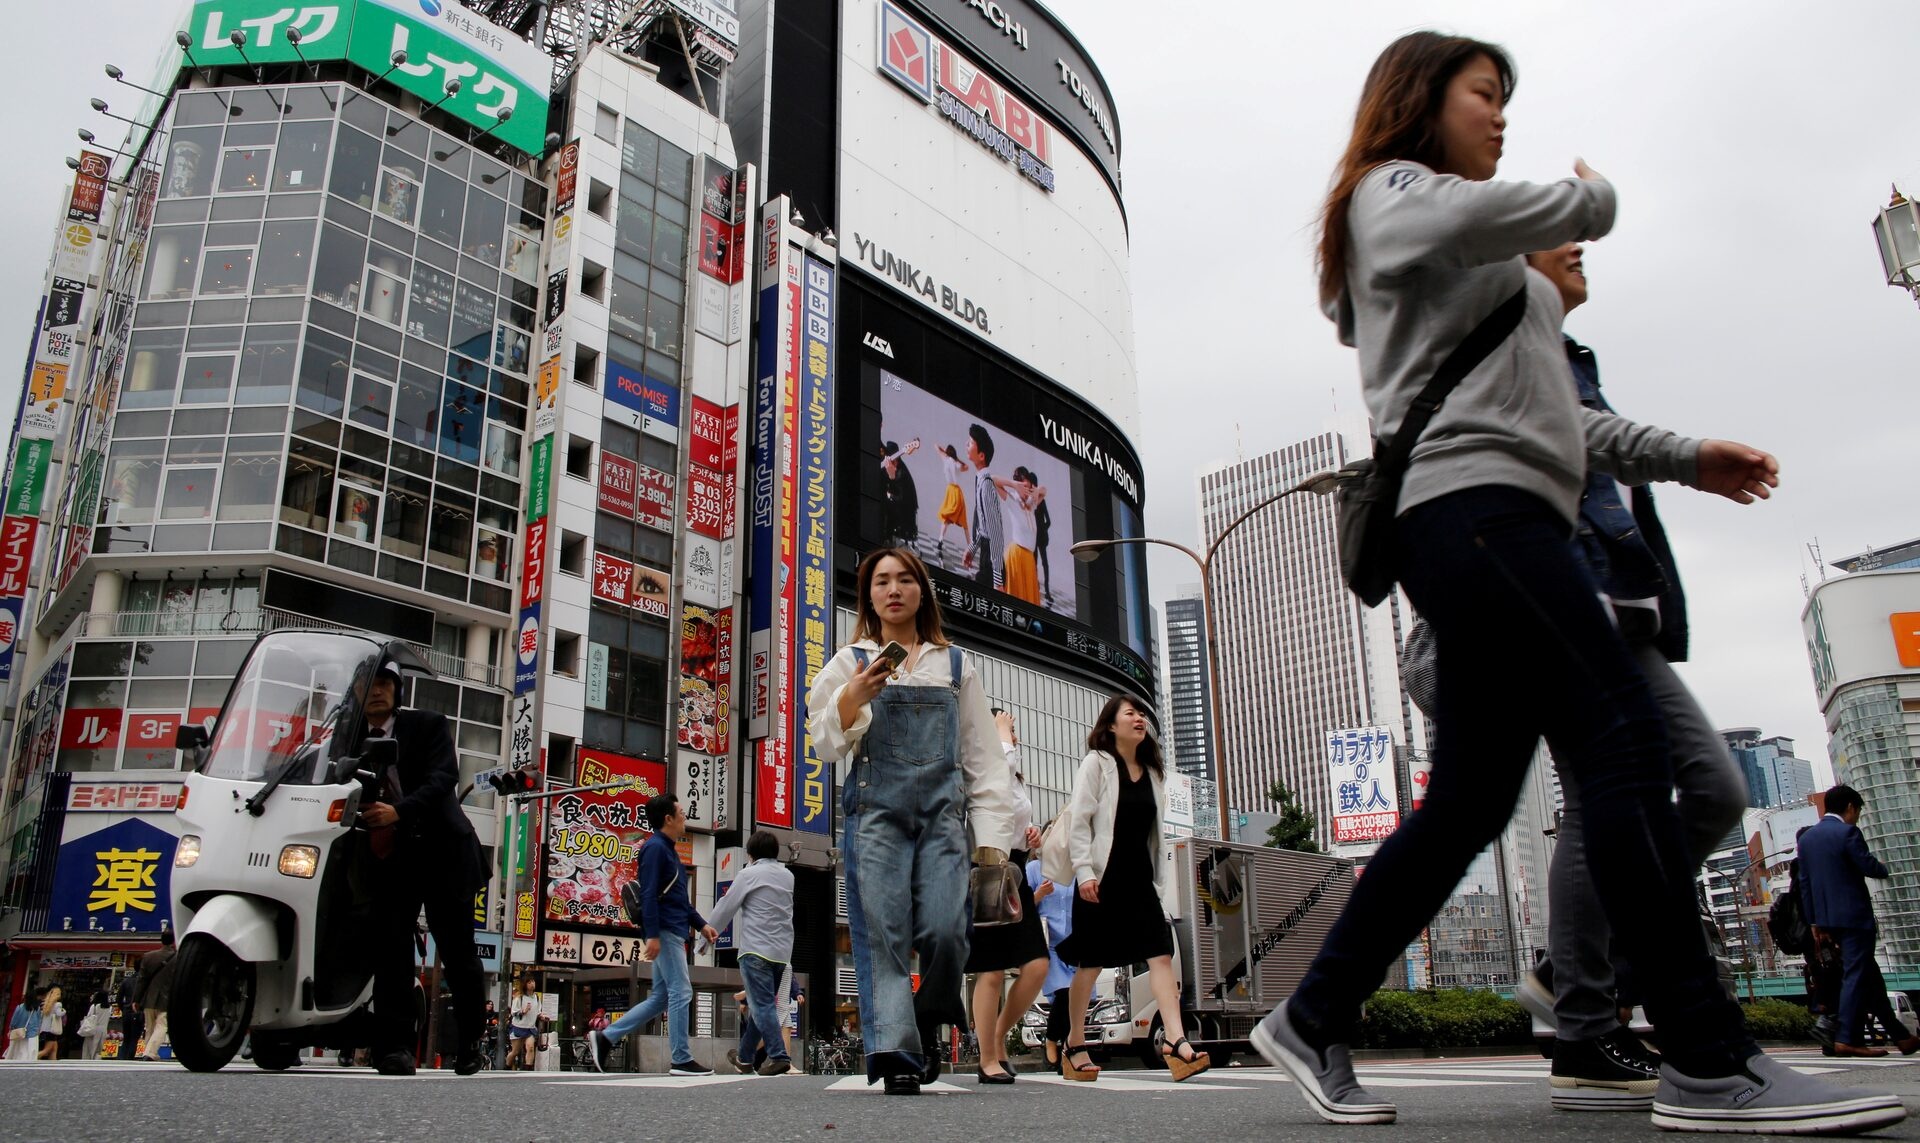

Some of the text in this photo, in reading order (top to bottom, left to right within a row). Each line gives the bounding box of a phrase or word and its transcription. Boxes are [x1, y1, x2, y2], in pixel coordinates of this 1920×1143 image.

[202, 6, 339, 50] レイク
[445, 9, 506, 52] 新生銀行
[389, 23, 519, 120] レイク
[939, 41, 1053, 169] LABI
[1056, 57, 1115, 154] TOSHIBA
[940, 91, 1015, 161] SHINJUKU
[70, 208, 84, 216] 8F
[769, 231, 778, 267] LABI
[55, 278, 70, 287] 7F
[812, 270, 825, 286] 1F
[854, 231, 992, 335] YUNIKA BLDG.
[812, 294, 826, 313] B1
[50, 331, 68, 341] HOT
[811, 318, 826, 337] B2
[49, 338, 66, 349] POT
[863, 331, 895, 359] LISA
[617, 375, 669, 407] PROMISE
[760, 375, 773, 405] For
[650, 402, 667, 415] プロミス
[695, 411, 720, 429] FAST
[694, 423, 720, 442] NAIL
[758, 406, 773, 450] Your
[606, 462, 631, 479] FAST
[709, 453, 719, 464] 6F
[1040, 413, 1138, 505] YUNIKA VISION
[605, 475, 630, 491] NAIL
[640, 465, 673, 489] ネイル
[706, 485, 721, 500] 03
[724, 473, 735, 538] まつげ本舗
[0, 520, 31, 592] アイフル
[526, 525, 543, 599] アイフル
[595, 557, 633, 583] まつげ
[598, 578, 626, 600] 本舗
[686, 580, 716, 595] Rydia
[520, 629, 538, 654] 薬
[718, 614, 732, 676] 飲み放題
[756, 673, 768, 718] LABI
[139, 719, 173, 739] 3F
[511, 698, 533, 770] 大勝軒
[1329, 728, 1389, 767] カラオケ
[1355, 761, 1368, 781] の
[71, 785, 179, 808] ミネドラッ
[290, 796, 320, 804] HONDA
[686, 761, 701, 821] 日高屋
[1338, 780, 1390, 812] 鉄人
[87, 847, 162, 913] 薬
[546, 946, 577, 960] 中華食堂
